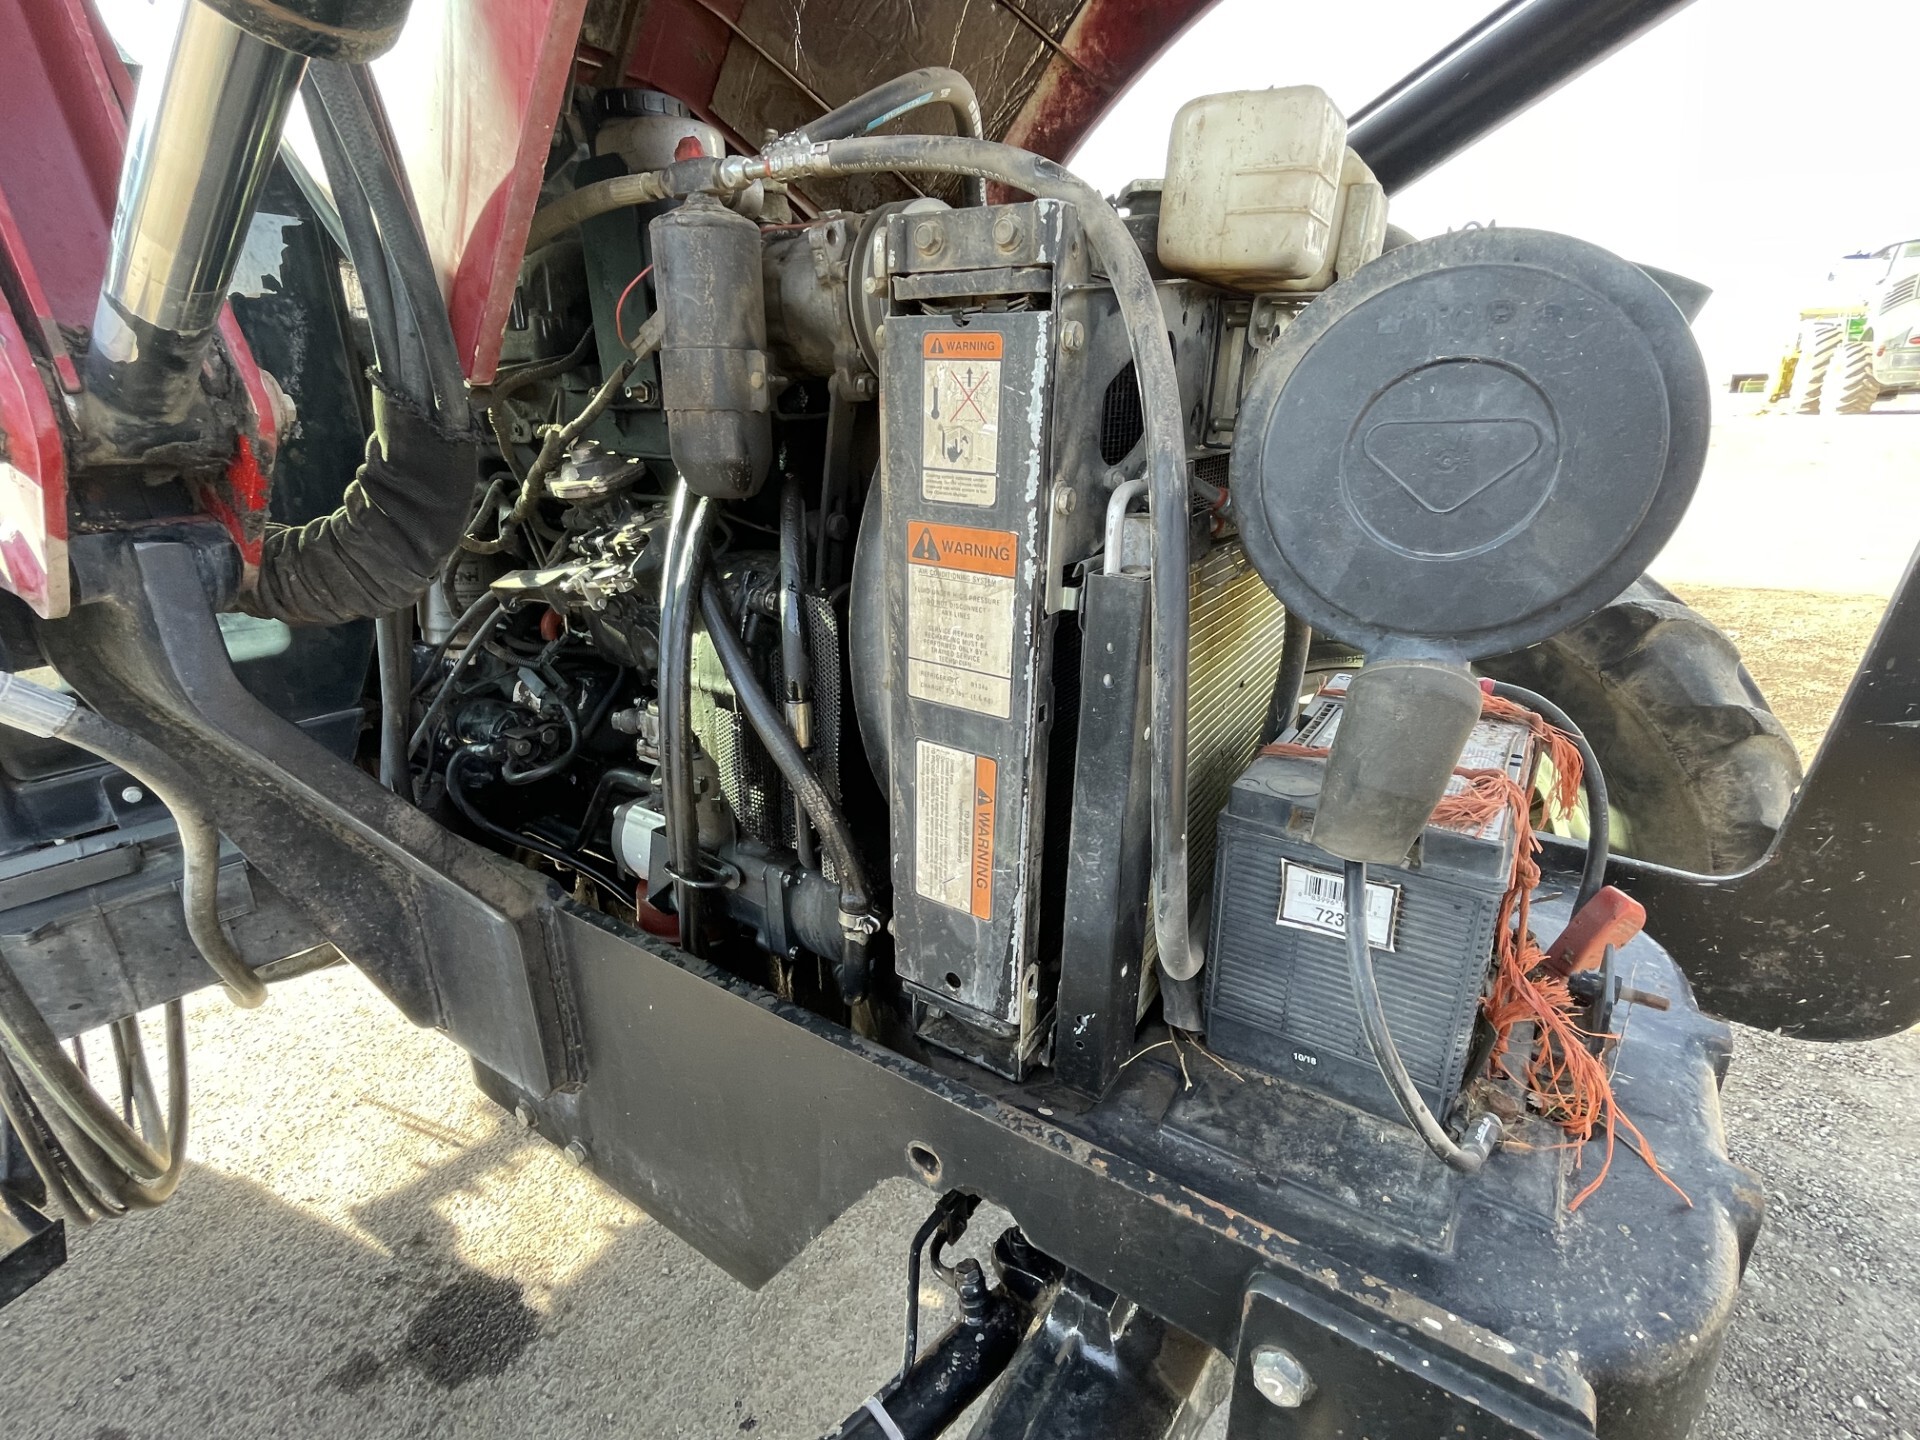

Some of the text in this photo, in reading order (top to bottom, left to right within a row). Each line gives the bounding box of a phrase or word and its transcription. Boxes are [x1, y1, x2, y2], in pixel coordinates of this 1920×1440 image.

[946, 341, 995, 351] WARNING
[942, 539, 1010, 561] WARNING
[929, 568, 971, 581] CONDITIONING
[969, 595, 1000, 606] PRESSURE
[949, 602, 987, 613] DISCONNECT
[954, 611, 970, 620] LINES
[976, 812, 991, 889] WARNING
[1315, 907, 1345, 927] 723
[1293, 1052, 1317, 1066] 10/18
